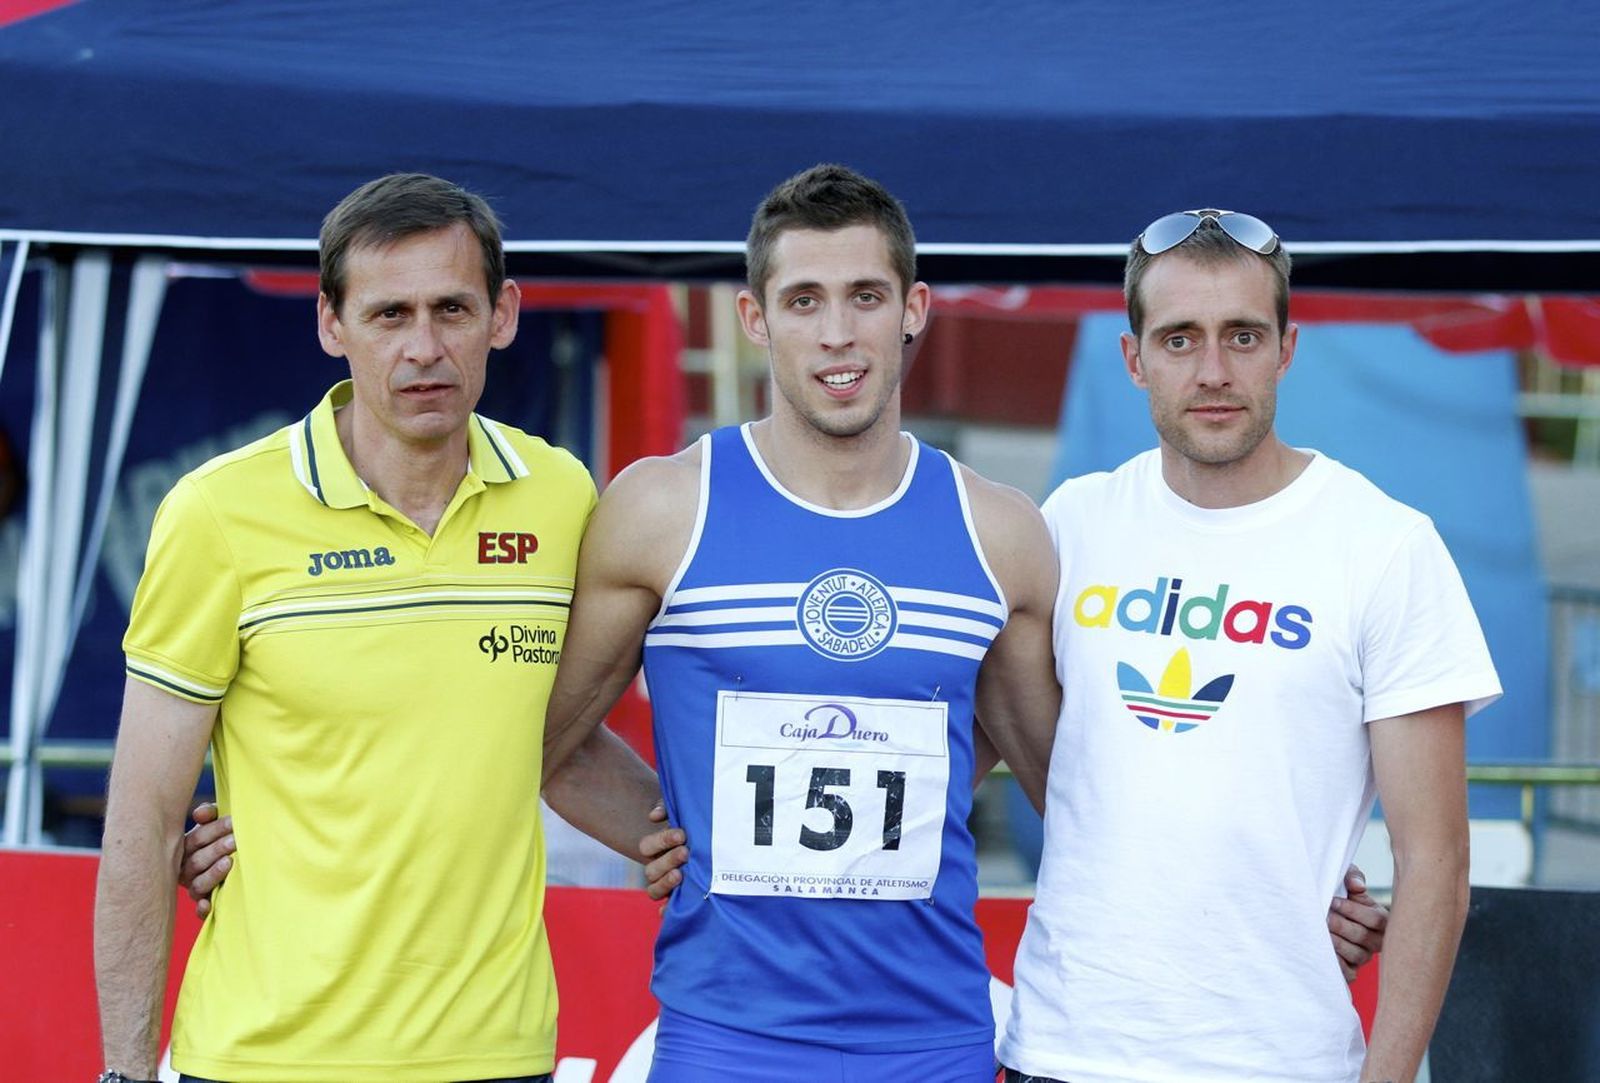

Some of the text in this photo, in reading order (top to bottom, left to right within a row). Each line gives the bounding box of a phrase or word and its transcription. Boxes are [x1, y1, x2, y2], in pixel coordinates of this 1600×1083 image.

[477, 532, 539, 564] ESP
[805, 576, 848, 625] JOVENTUT
[1073, 577, 1313, 650] adidas
[510, 625, 556, 644] Divina
[817, 631, 880, 654] SABADELL
[746, 764, 906, 851] 151
[773, 885, 880, 896] SALAMANCA
[793, 876, 857, 886] PROVINCIAL
[860, 878, 874, 887] DE
[876, 879, 928, 889] ATLETISMO
